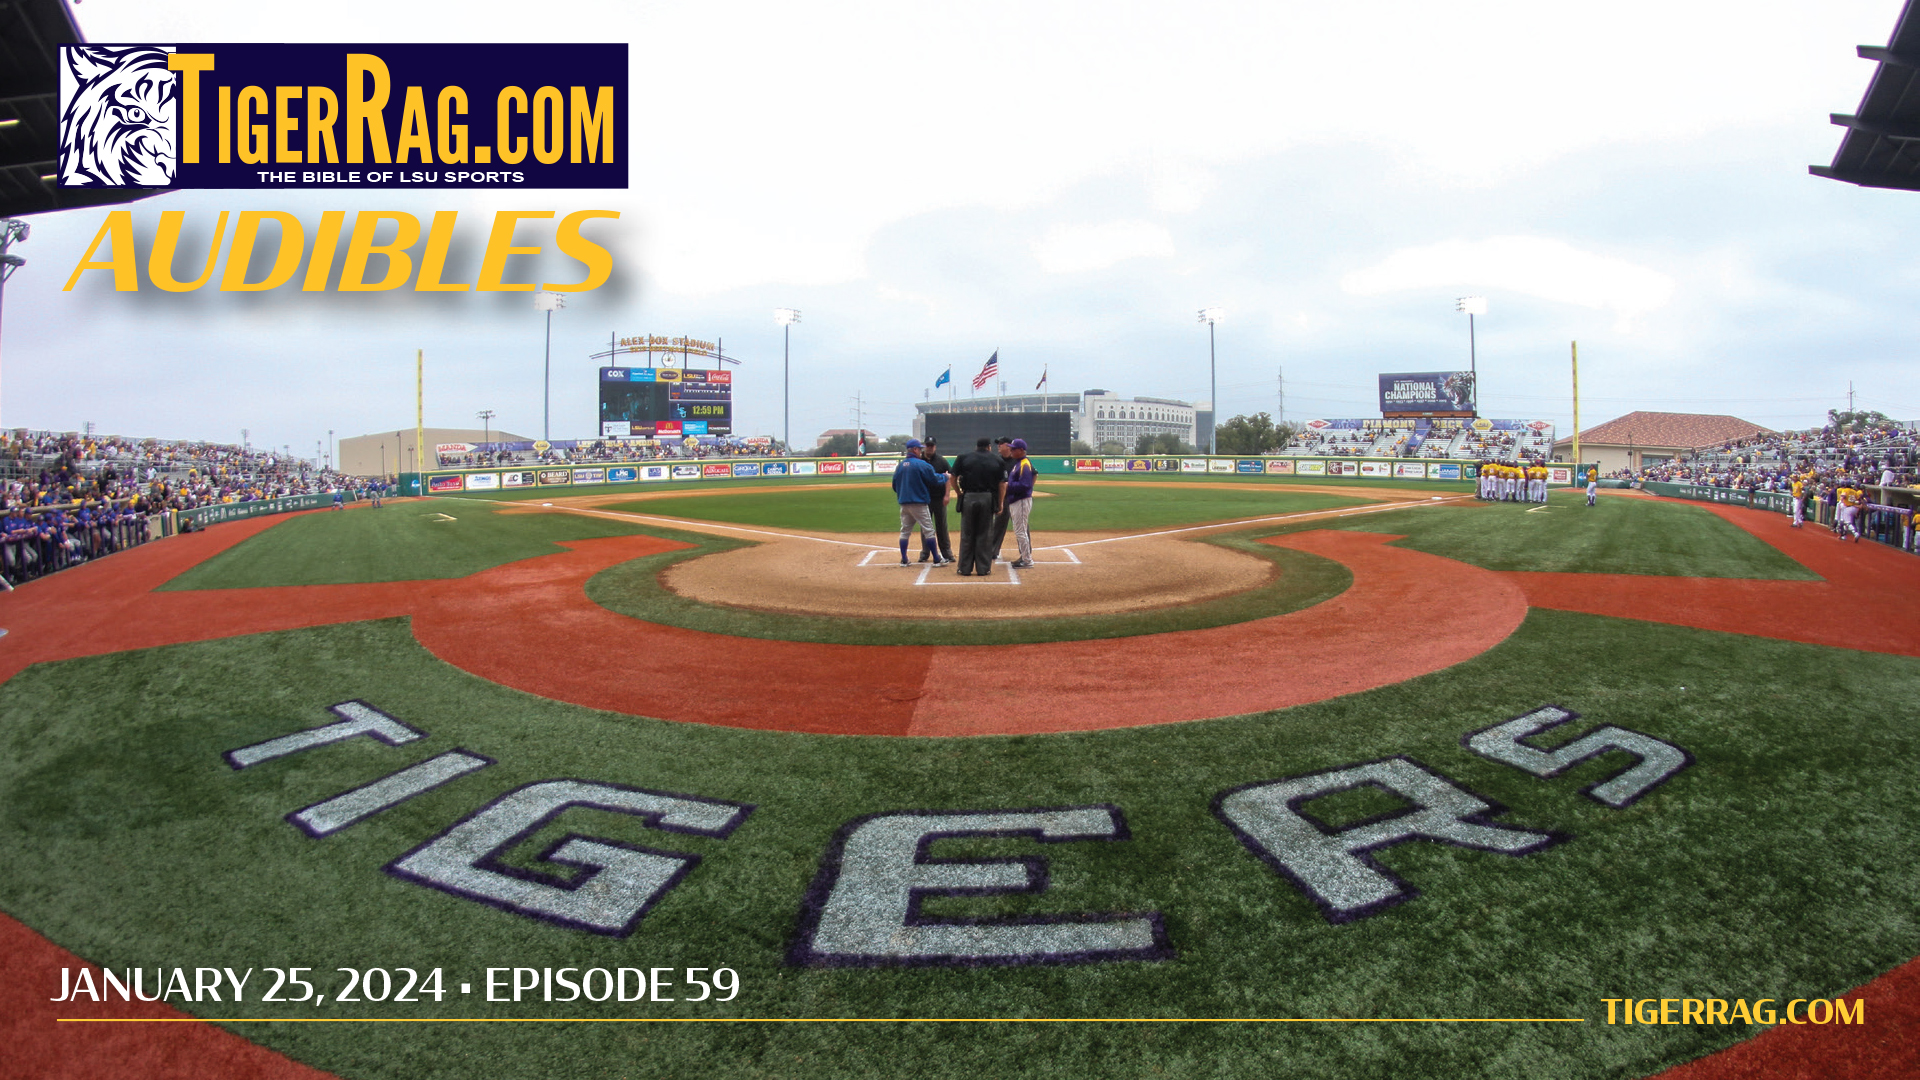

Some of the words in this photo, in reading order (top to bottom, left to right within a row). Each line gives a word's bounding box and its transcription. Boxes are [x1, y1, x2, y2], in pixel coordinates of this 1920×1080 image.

[620, 336, 645, 347] ALEX
[649, 335, 669, 345] BOX
[673, 337, 715, 351] STADIUM
[607, 370, 625, 378] COX
[1394, 382, 1436, 391] NATIONAL
[1385, 390, 1437, 400] CHAMPIONS
[692, 406, 711, 415] 12:59
[712, 406, 724, 415] PM
[1362, 419, 1416, 429] DIAMOND
[224, 699, 1695, 967] TIGERS
